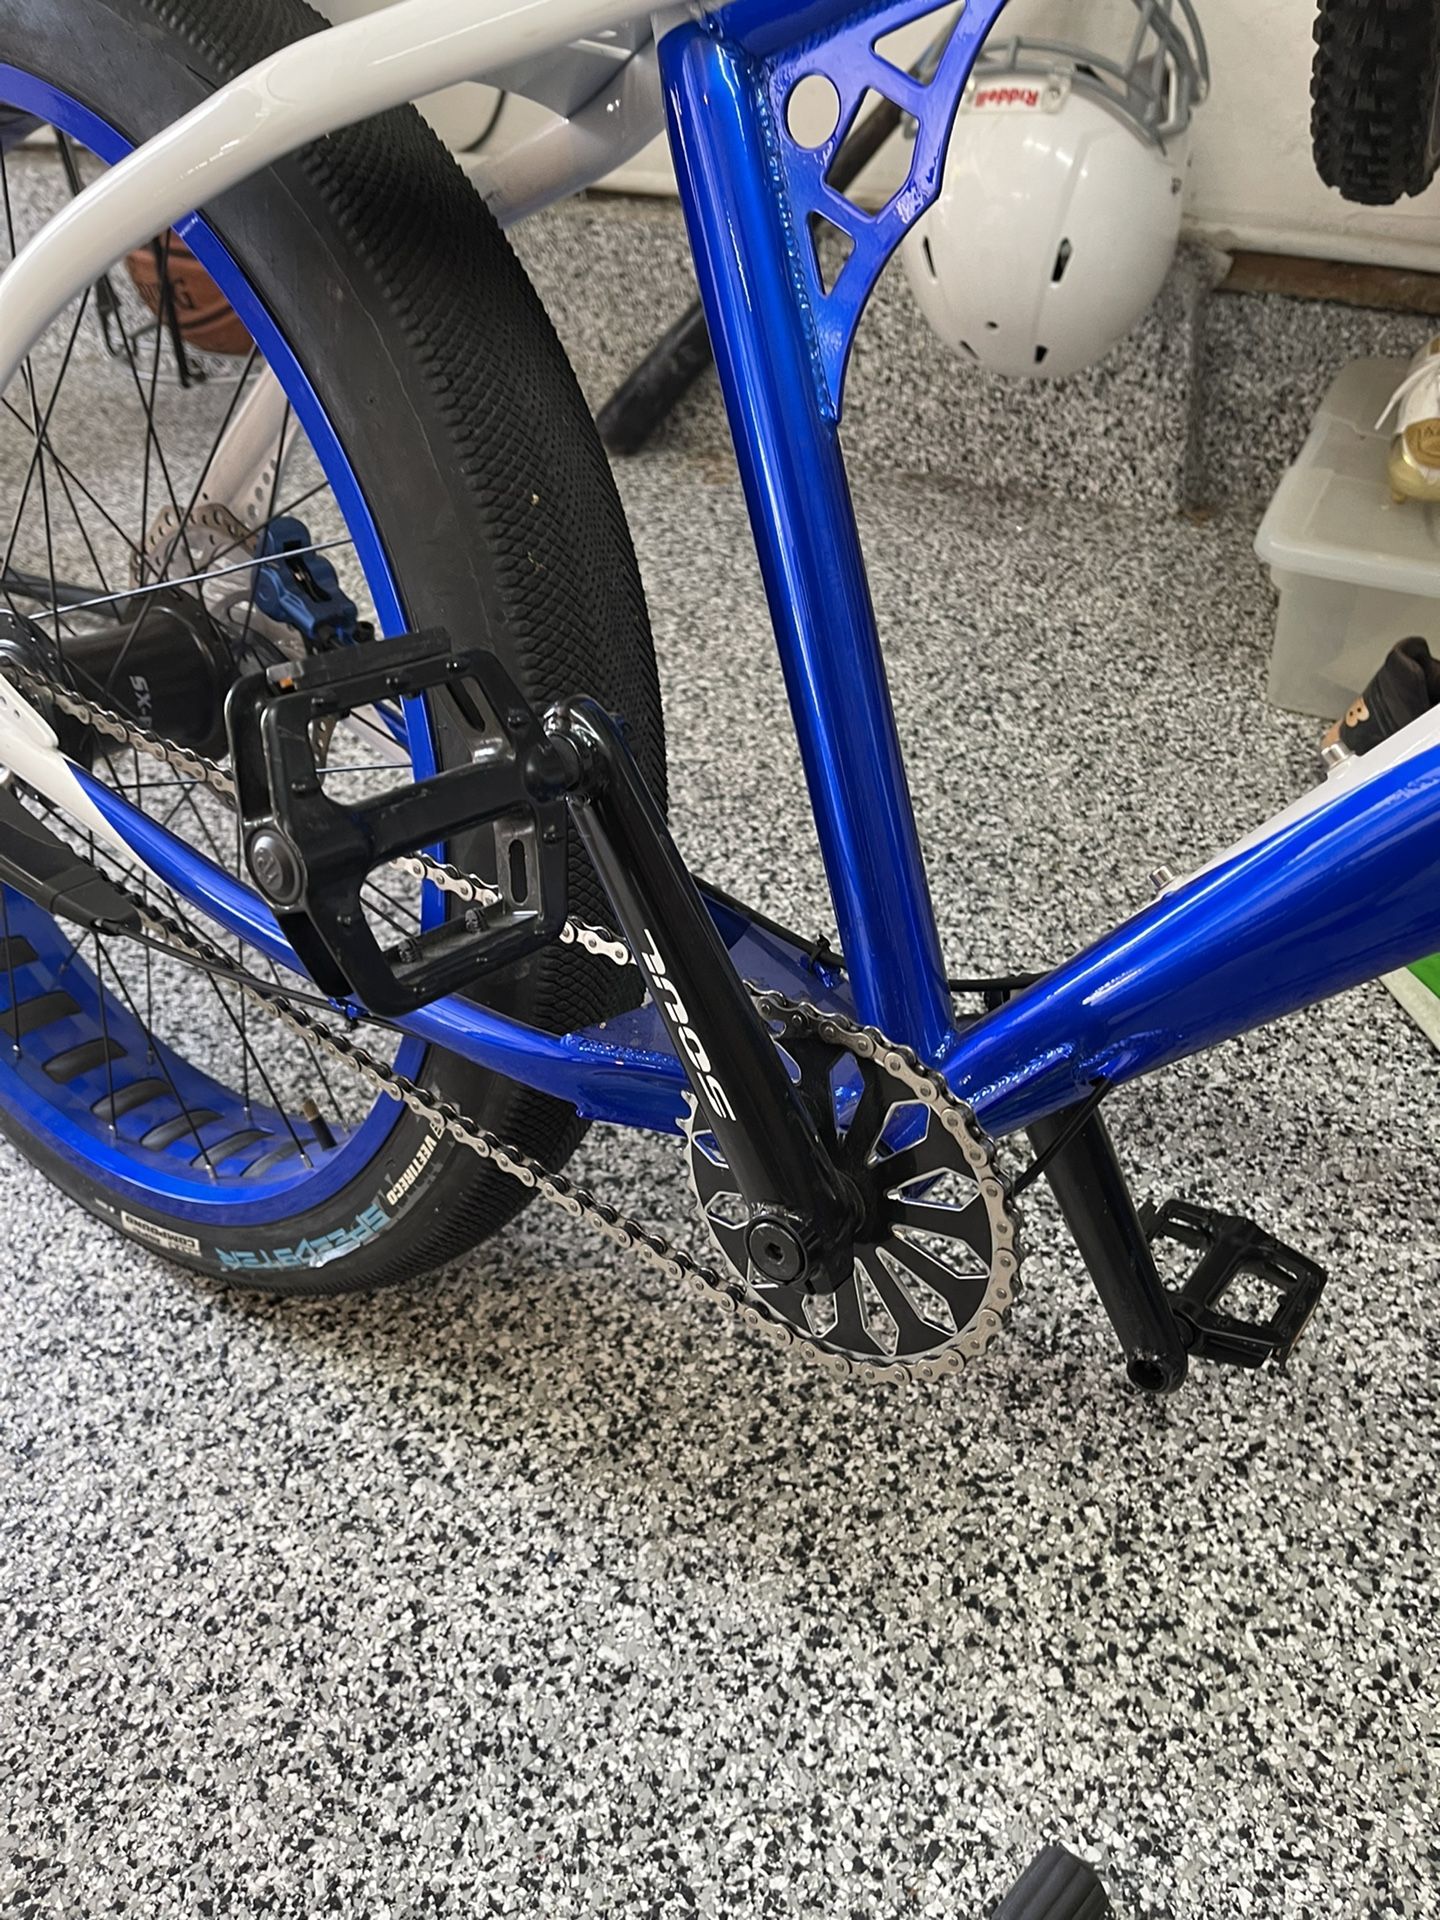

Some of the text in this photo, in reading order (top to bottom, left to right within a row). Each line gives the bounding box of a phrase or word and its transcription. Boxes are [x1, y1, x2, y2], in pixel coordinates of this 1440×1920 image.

[974, 88, 1038, 108] Riddell
[641, 928, 737, 1121] SOUL
[386, 1134, 438, 1206] VEETIRECO
[125, 1215, 196, 1248] COMPOUND
[214, 1202, 392, 1270] SPEEDSTER
